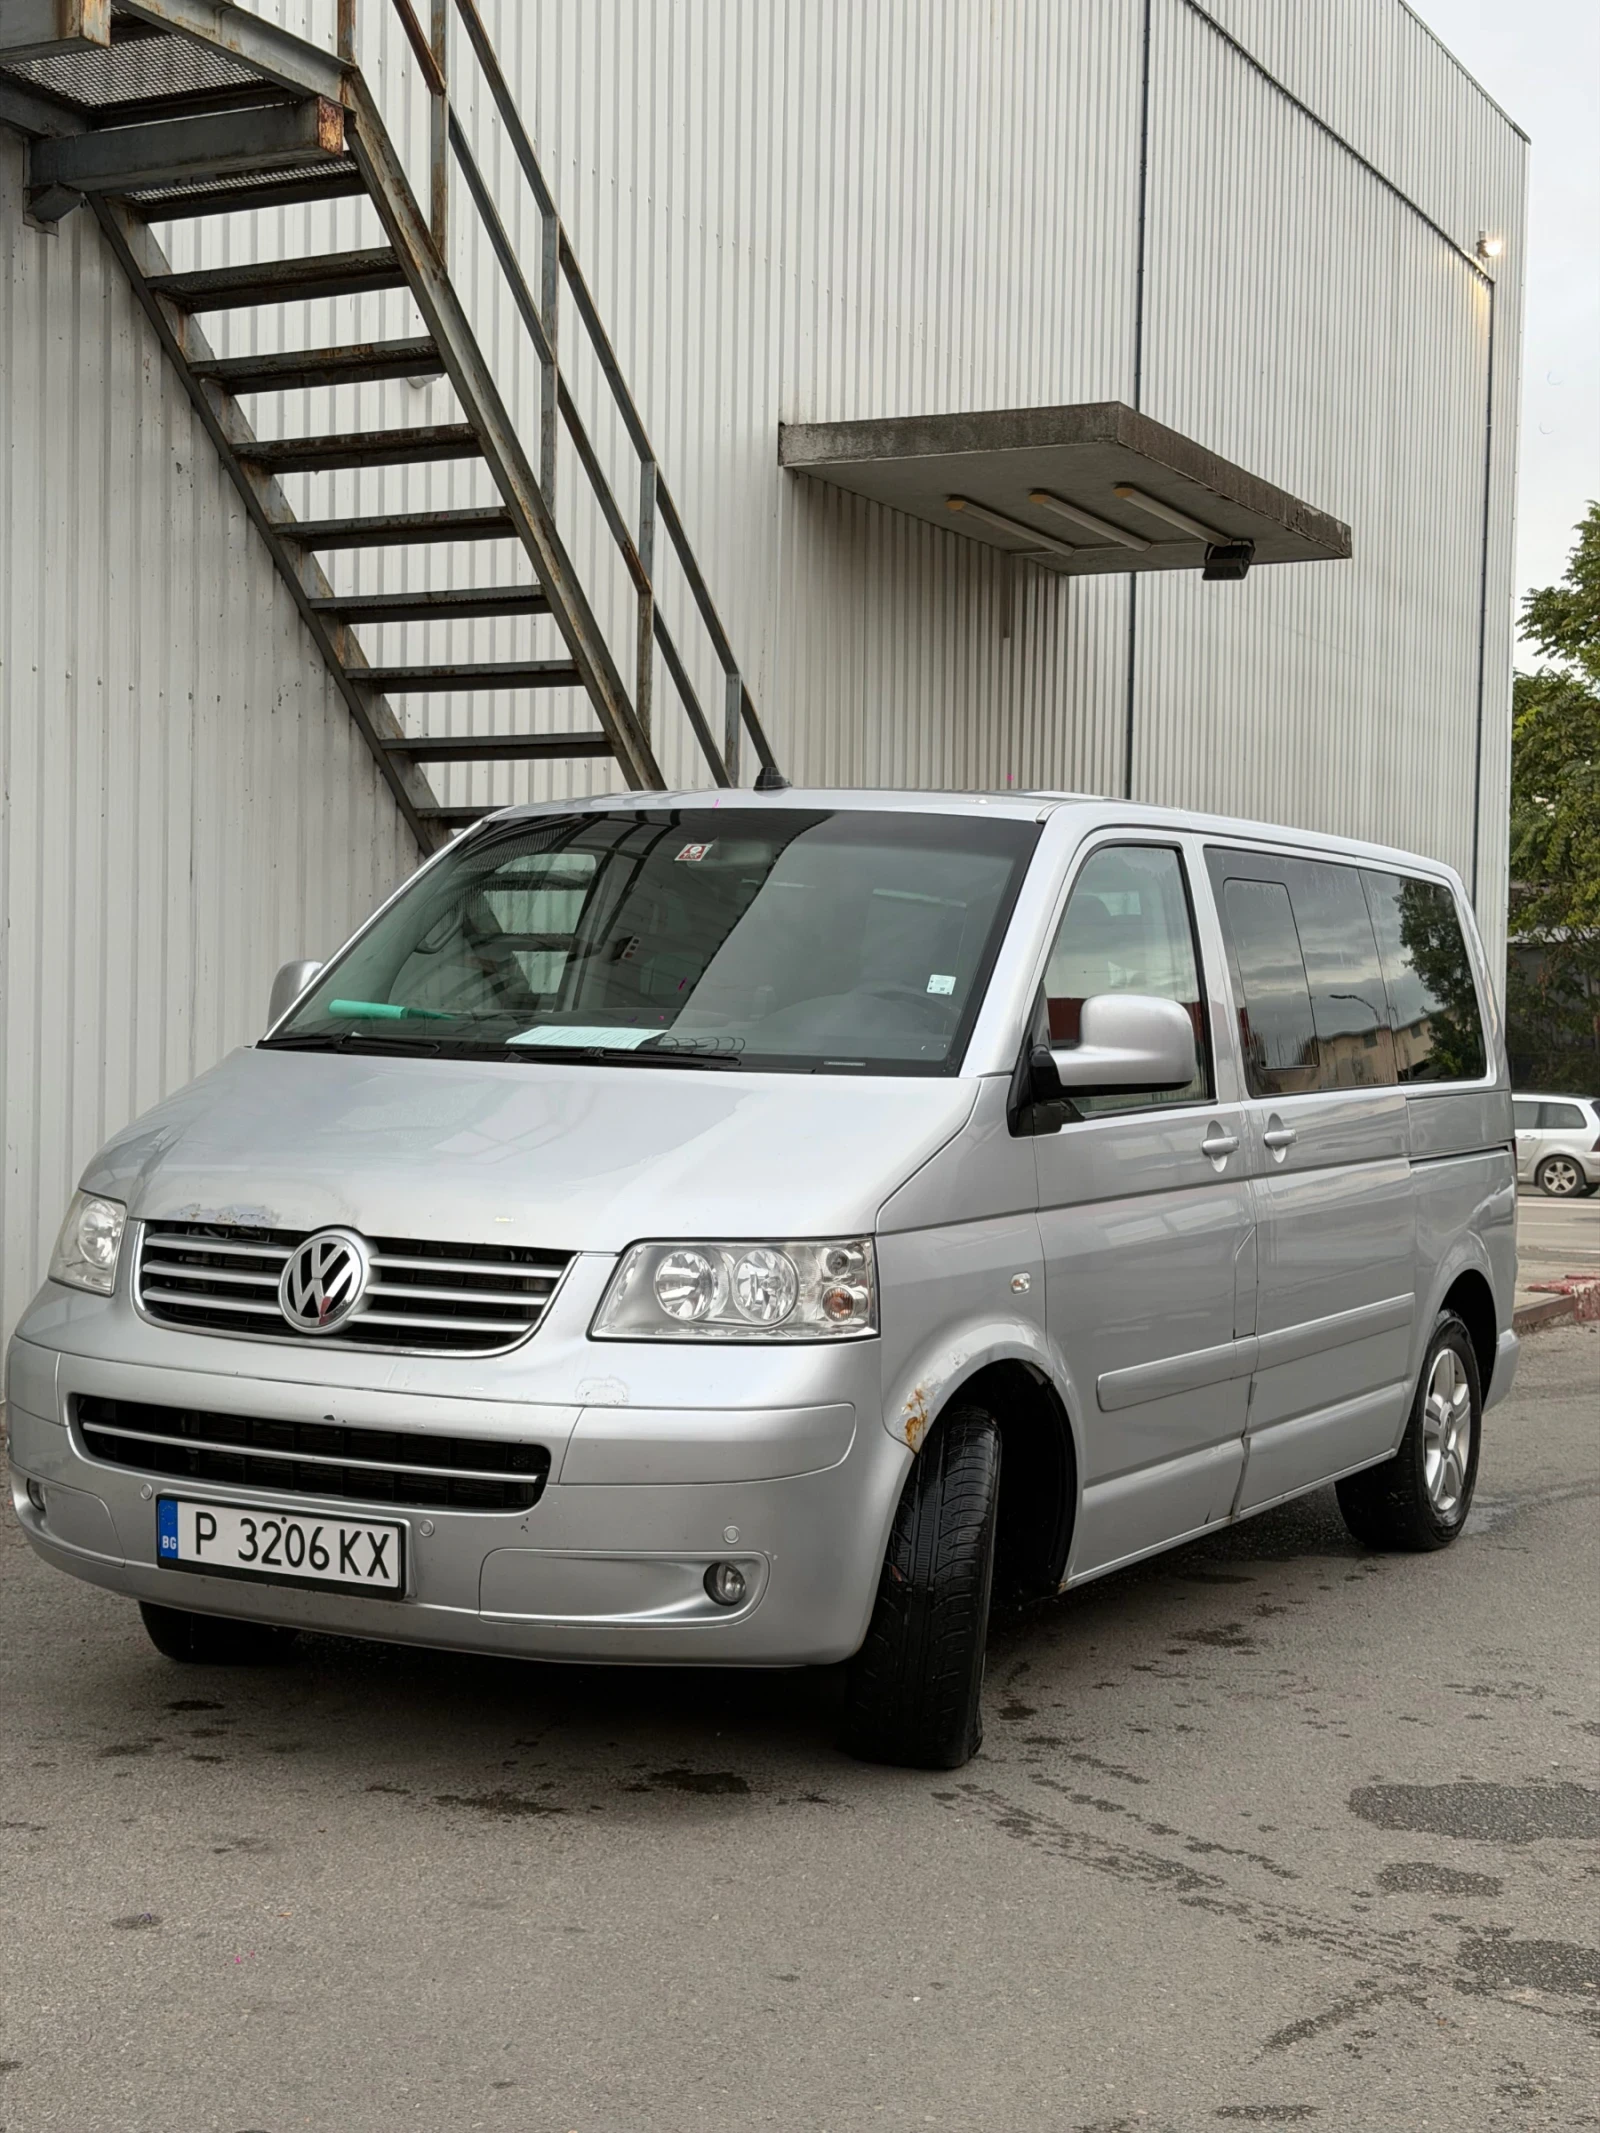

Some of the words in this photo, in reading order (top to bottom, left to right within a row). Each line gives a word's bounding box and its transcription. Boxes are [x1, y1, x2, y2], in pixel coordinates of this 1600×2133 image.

[284, 1235, 363, 1329] VW
[162, 1535, 177, 1550] BG
[195, 1511, 217, 1555] P
[238, 1518, 330, 1571] 3206
[339, 1529, 390, 1579] KX
